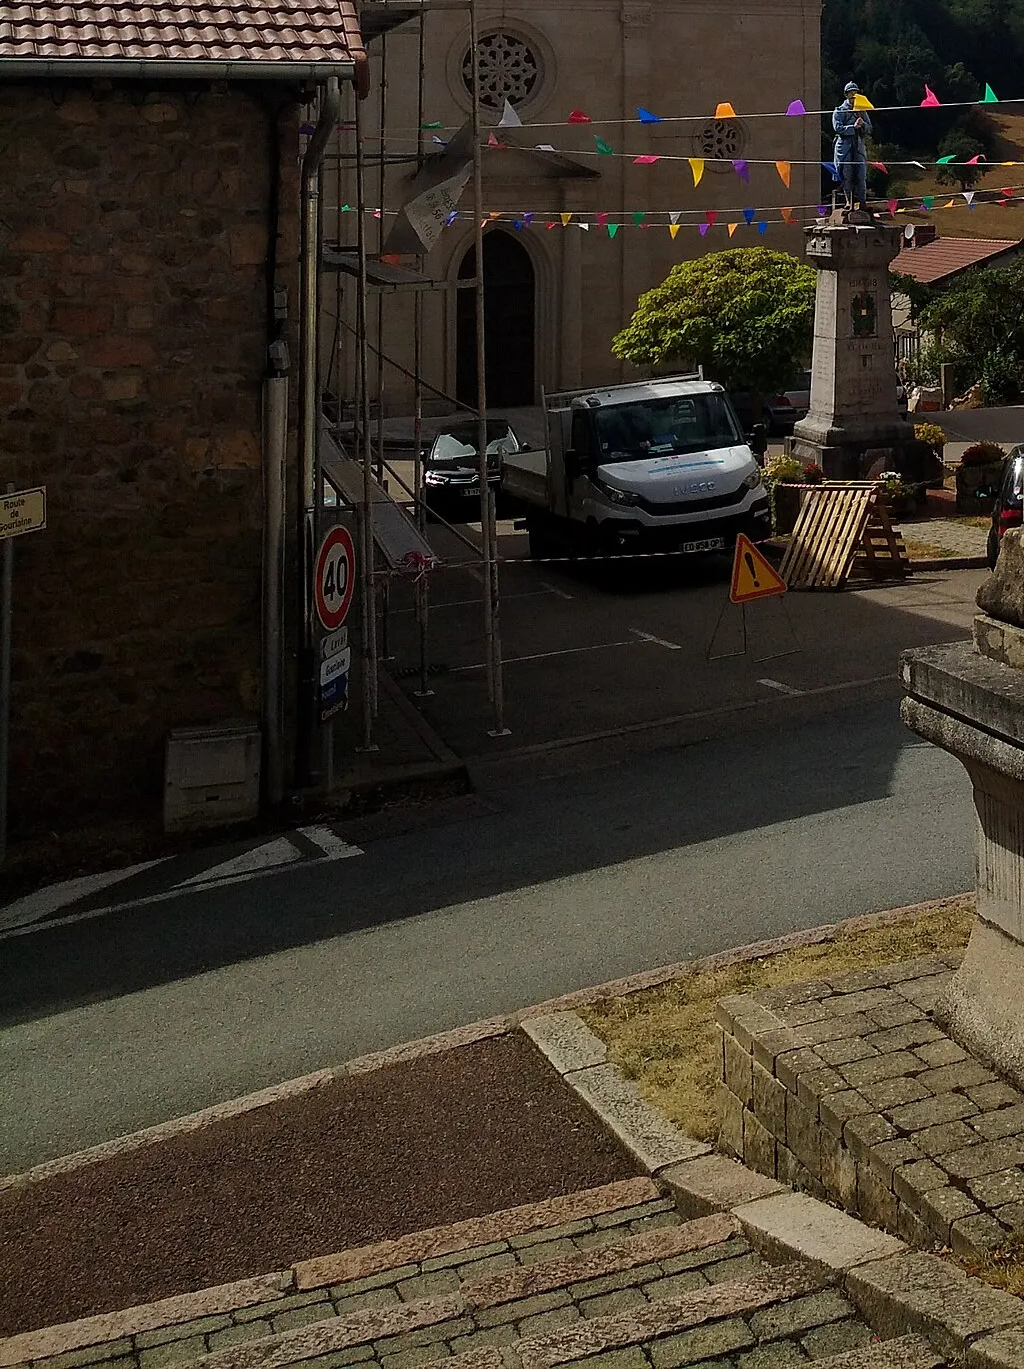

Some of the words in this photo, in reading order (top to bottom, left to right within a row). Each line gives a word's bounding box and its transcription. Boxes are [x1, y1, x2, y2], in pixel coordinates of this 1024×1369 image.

[674, 481, 716, 496] IVECO
[3, 498, 25, 510] Route
[10, 509, 19, 519] de
[324, 555, 347, 601] 40
